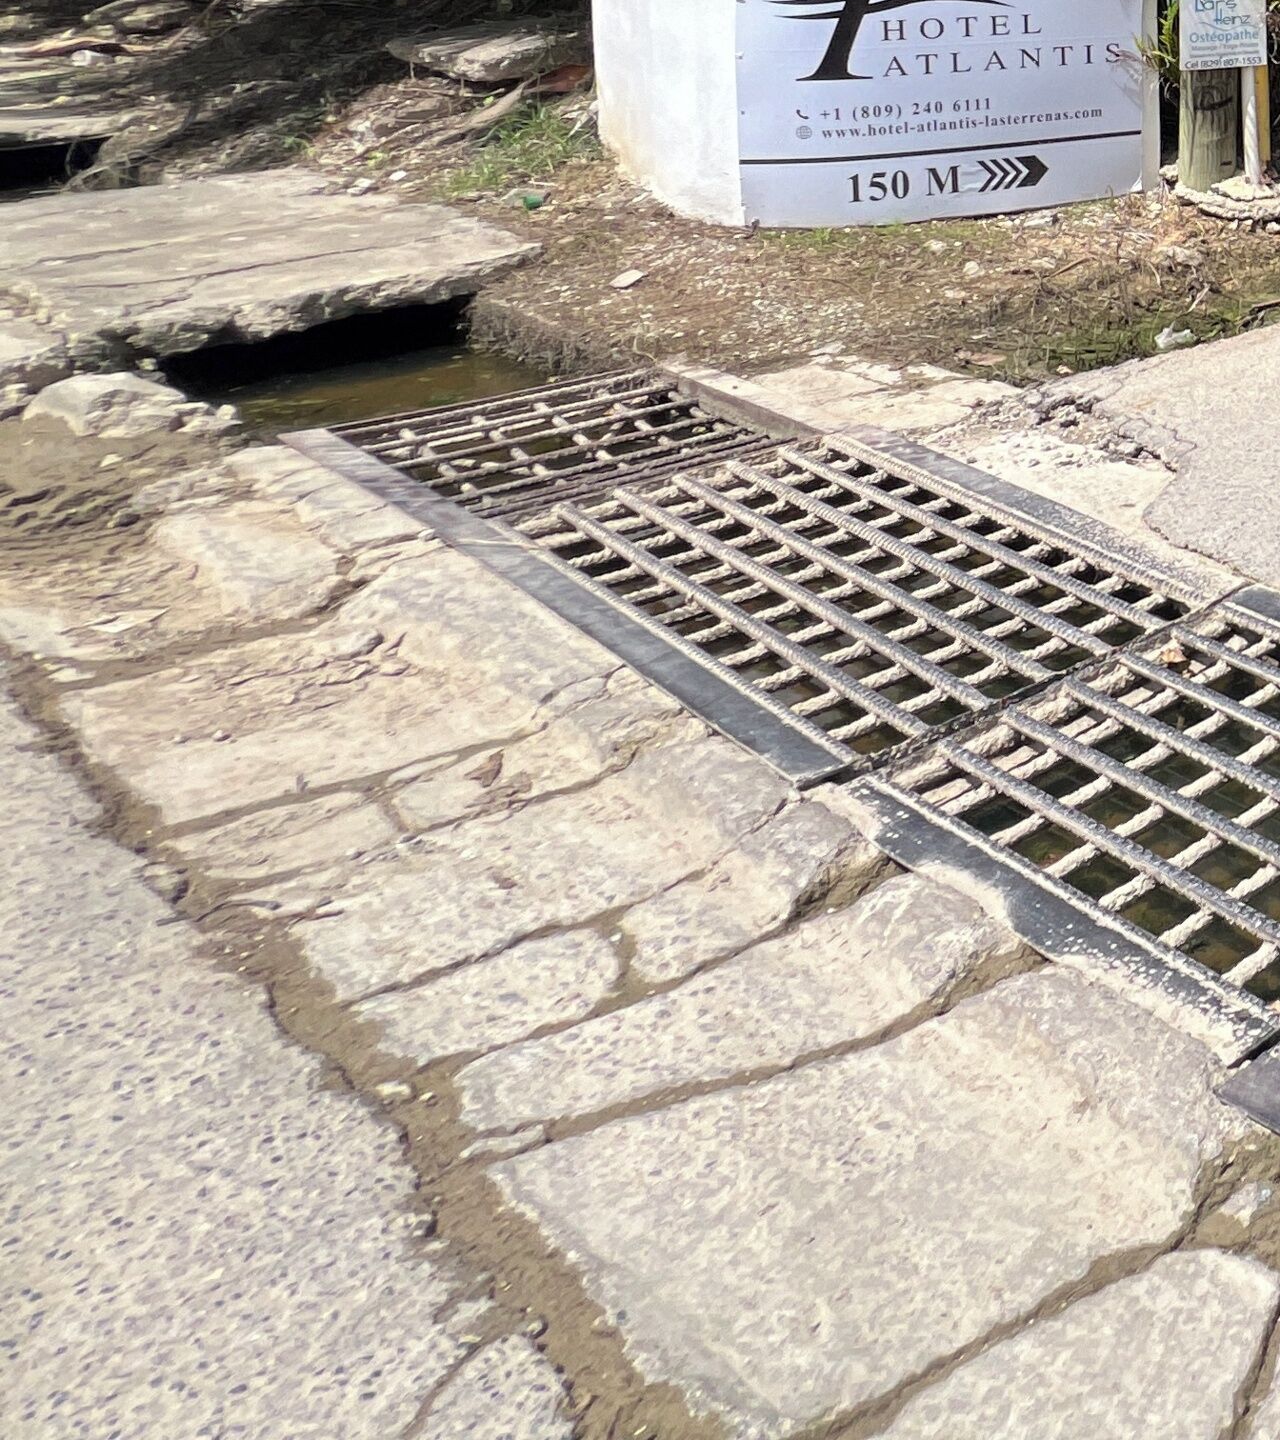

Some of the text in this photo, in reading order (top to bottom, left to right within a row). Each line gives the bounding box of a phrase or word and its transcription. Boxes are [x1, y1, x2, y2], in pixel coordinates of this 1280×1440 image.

[881, 13, 1042, 42] HOTEL
[1189, 29, 1259, 44] Ostéopathe
[883, 42, 1124, 77] ATLANTIS
[1185, 61, 1199, 69] Cel
[819, 98, 992, 122] +1 (809) 240 6111
[822, 107, 1103, 139] www.hotel-atlantis-lasterrenas.com
[848, 164, 961, 203] 150 M
